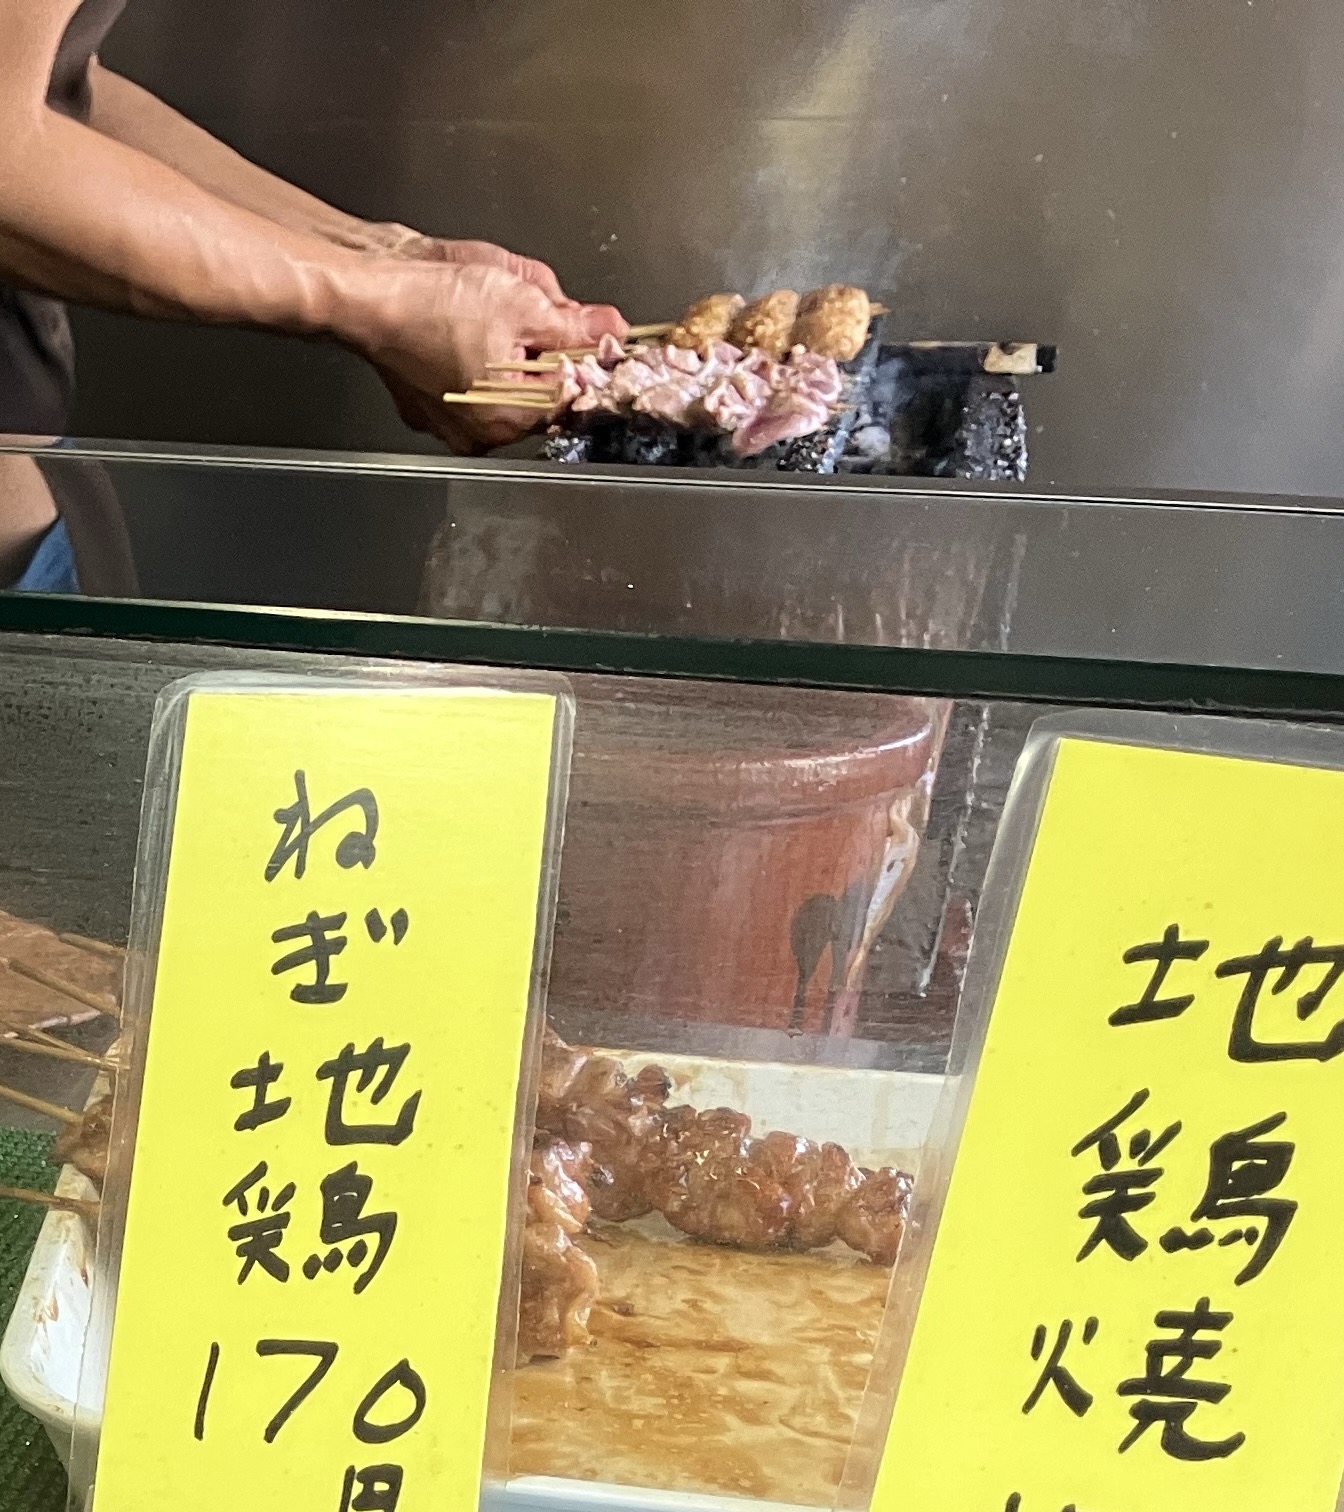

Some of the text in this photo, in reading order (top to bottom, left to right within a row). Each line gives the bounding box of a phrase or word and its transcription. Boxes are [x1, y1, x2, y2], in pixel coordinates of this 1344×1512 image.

[223, 770, 422, 1295] ねぎ地鶏
[1022, 924, 1344, 1461] 地鶏焼
